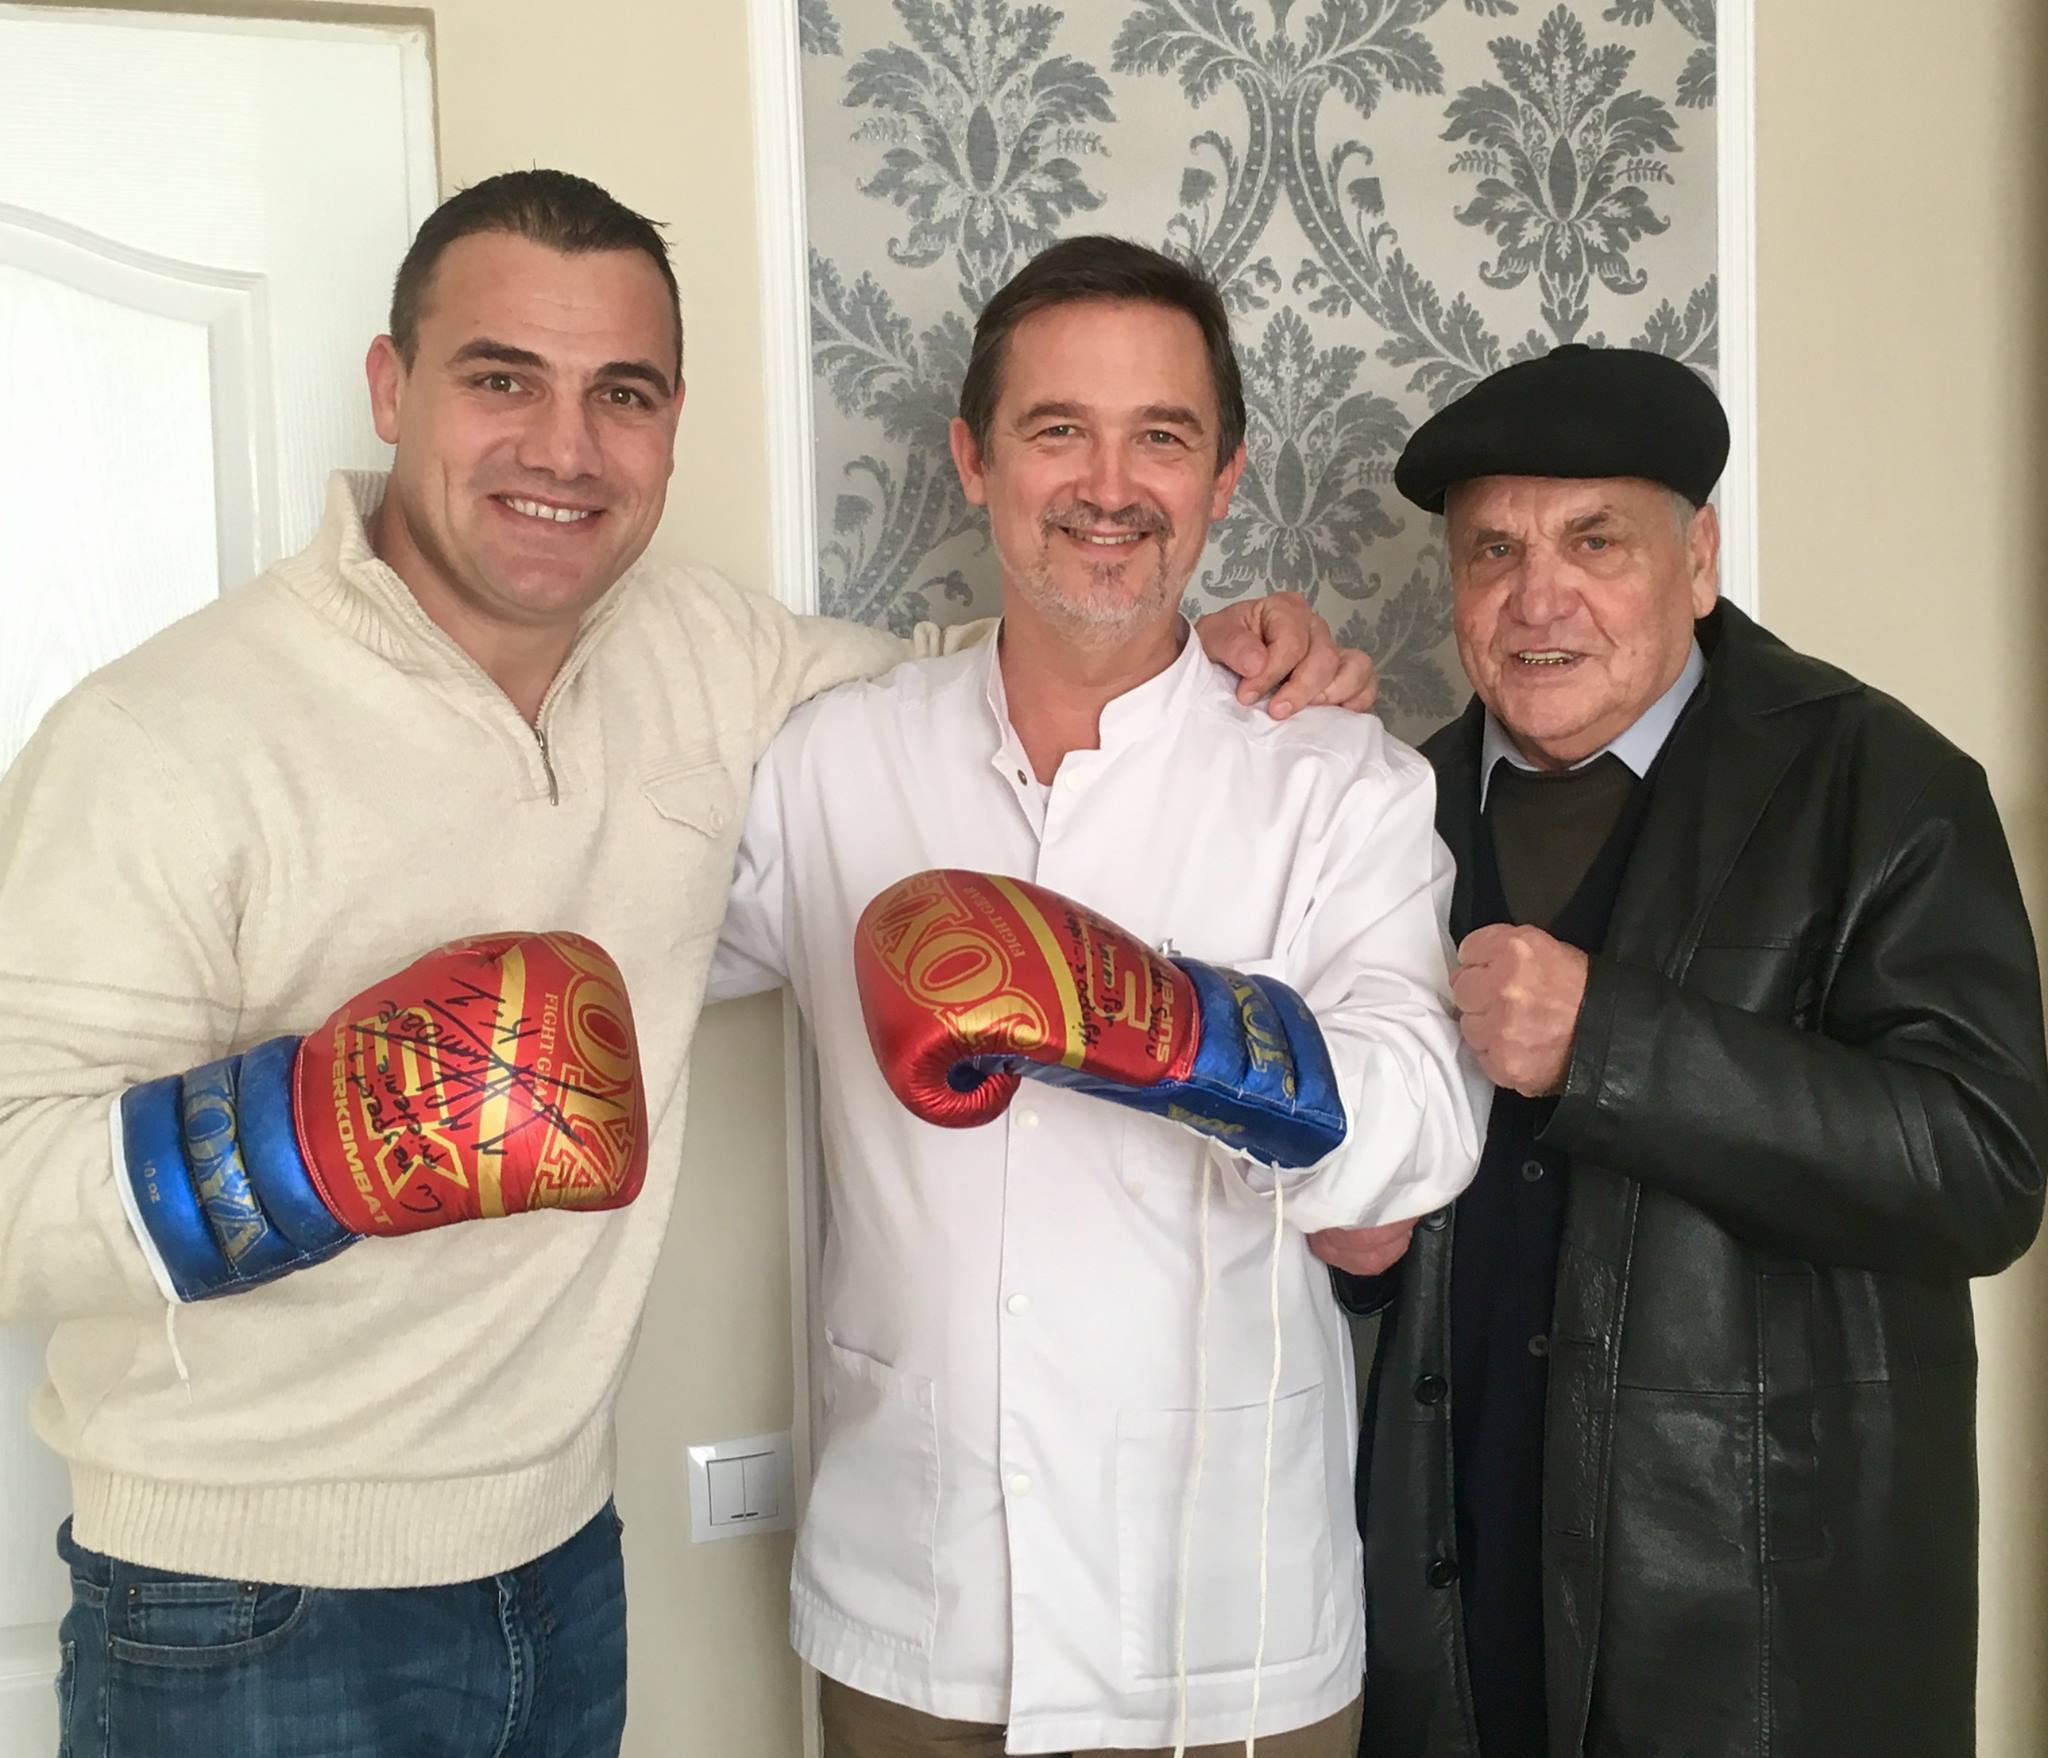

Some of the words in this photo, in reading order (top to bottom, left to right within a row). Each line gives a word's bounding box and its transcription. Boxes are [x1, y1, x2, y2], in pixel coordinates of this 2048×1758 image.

[865, 868, 1050, 1052] JOYA
[992, 912, 1027, 959] FIGHT
[538, 991, 559, 1056] FIGHT
